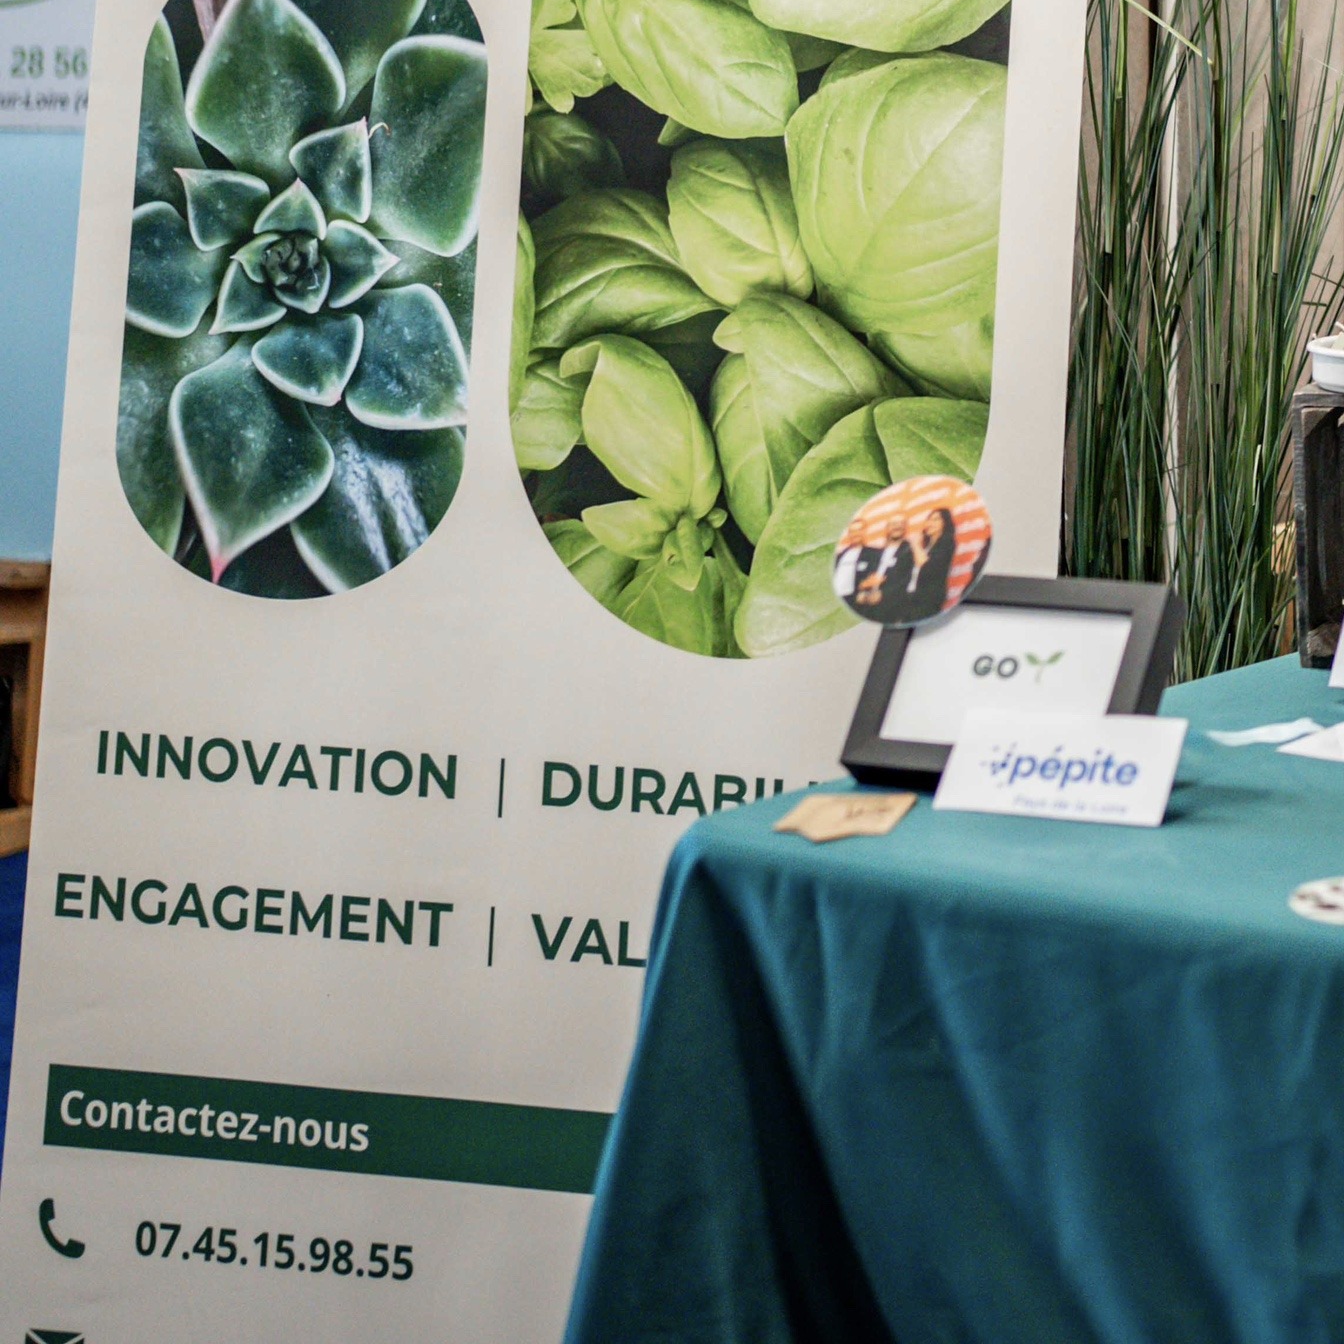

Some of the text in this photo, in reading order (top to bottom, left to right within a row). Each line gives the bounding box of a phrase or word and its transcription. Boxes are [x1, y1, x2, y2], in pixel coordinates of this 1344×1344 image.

[972, 654, 1020, 680] GO
[96, 730, 820, 816] INNOVATION DURABI
[1008, 744, 1139, 790] pépite
[54, 872, 648, 968] ENGAGEMENT VAL
[59, 1089, 370, 1152] Contactez-nous
[135, 1220, 414, 1281] 07.45.15.98.55
